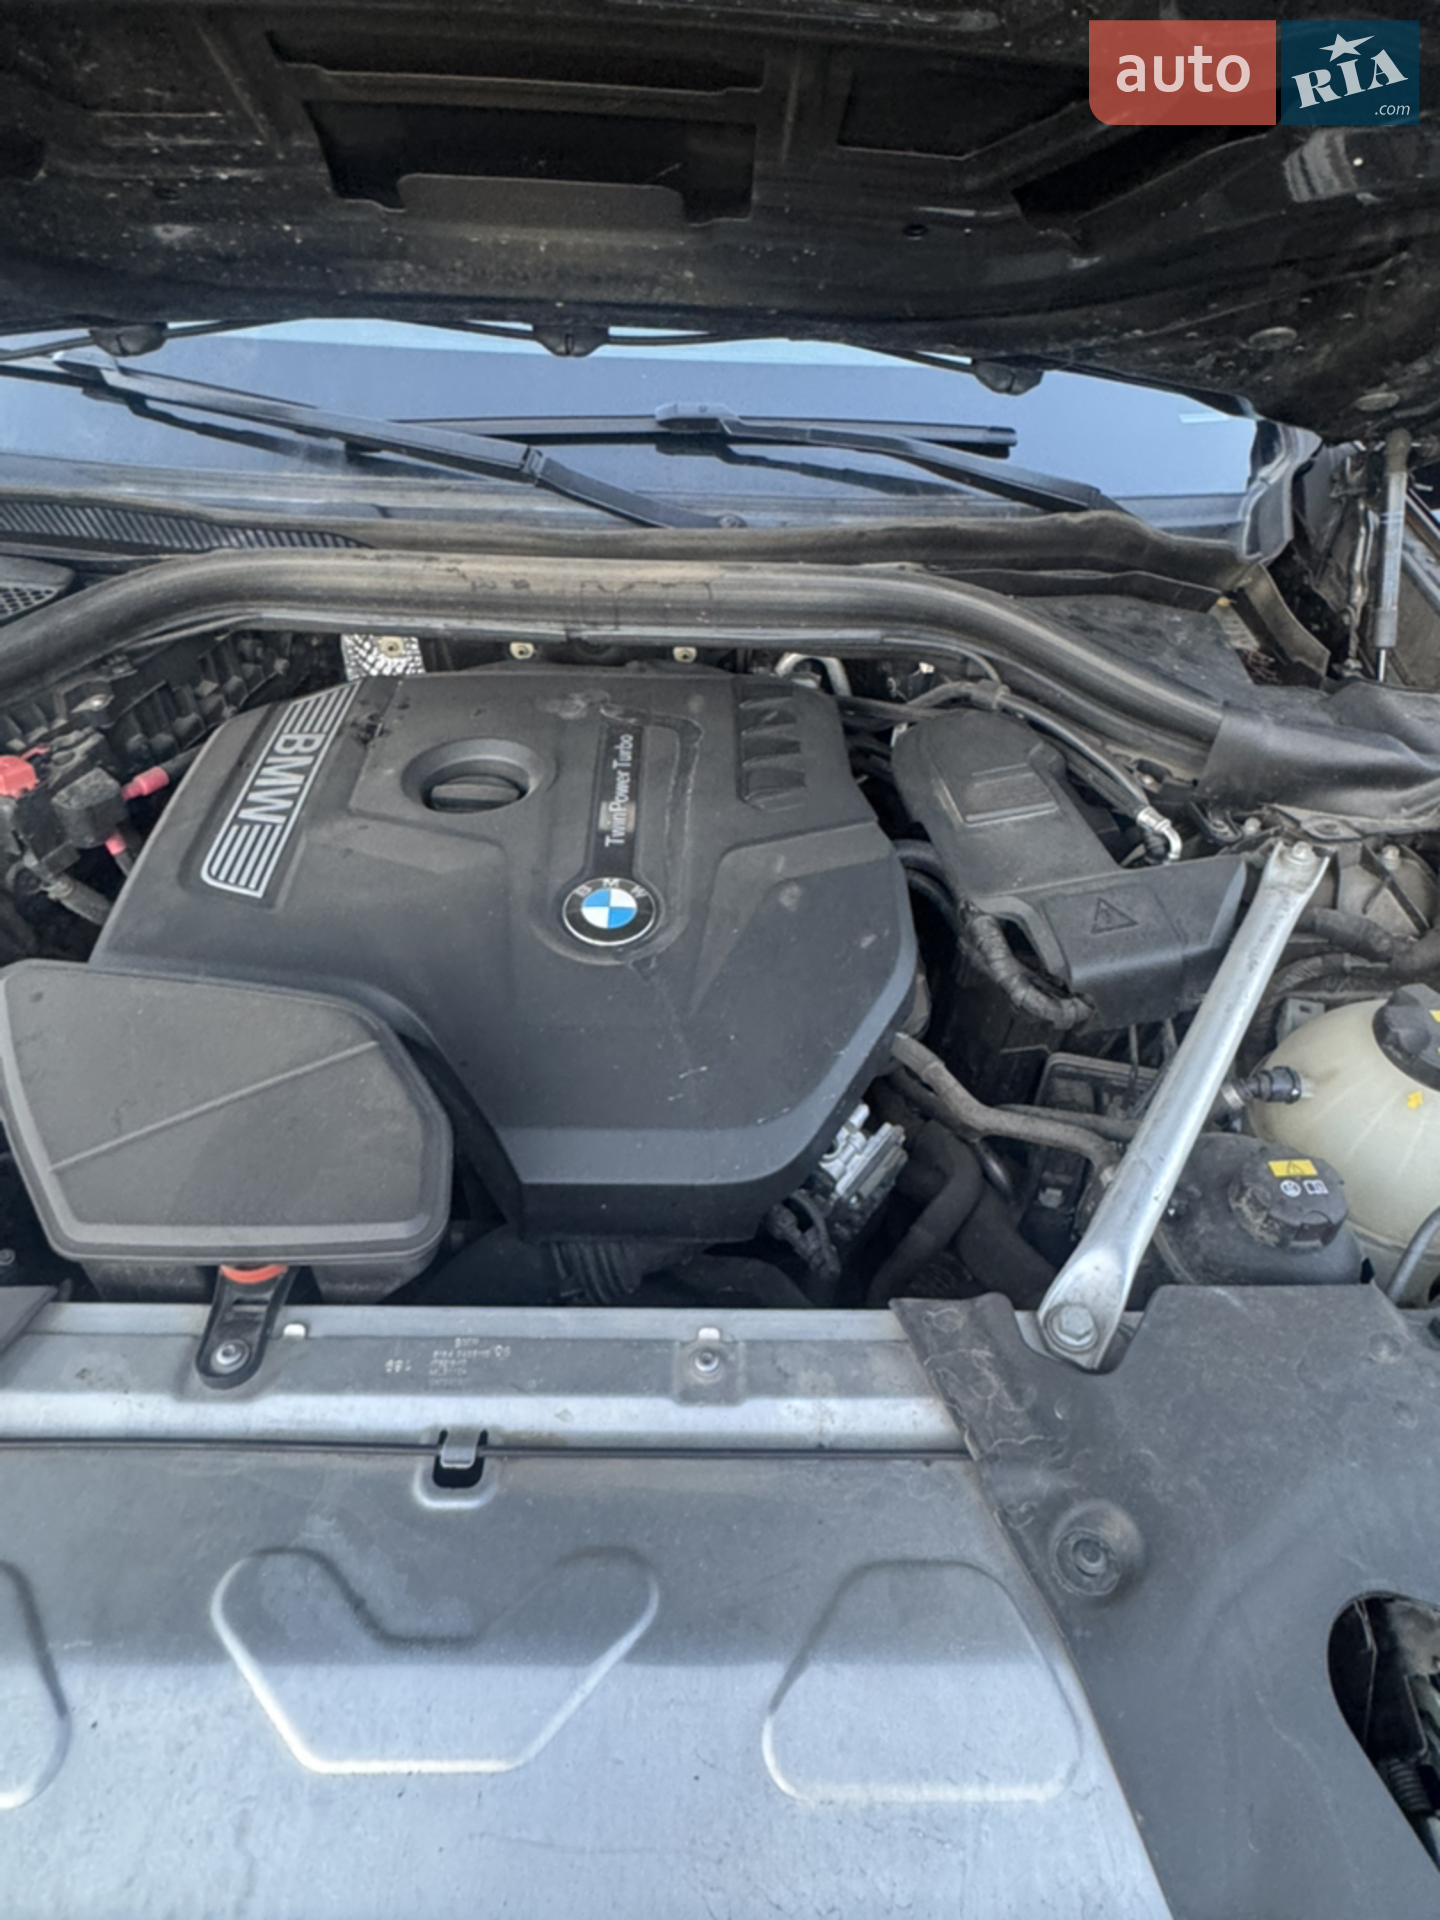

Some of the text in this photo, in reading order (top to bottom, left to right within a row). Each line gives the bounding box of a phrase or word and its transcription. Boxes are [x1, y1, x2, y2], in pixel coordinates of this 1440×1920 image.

[237, 733, 326, 824] BMW
[604, 733, 634, 848] TwinPower Turbo
[574, 877, 649, 900] BMW
